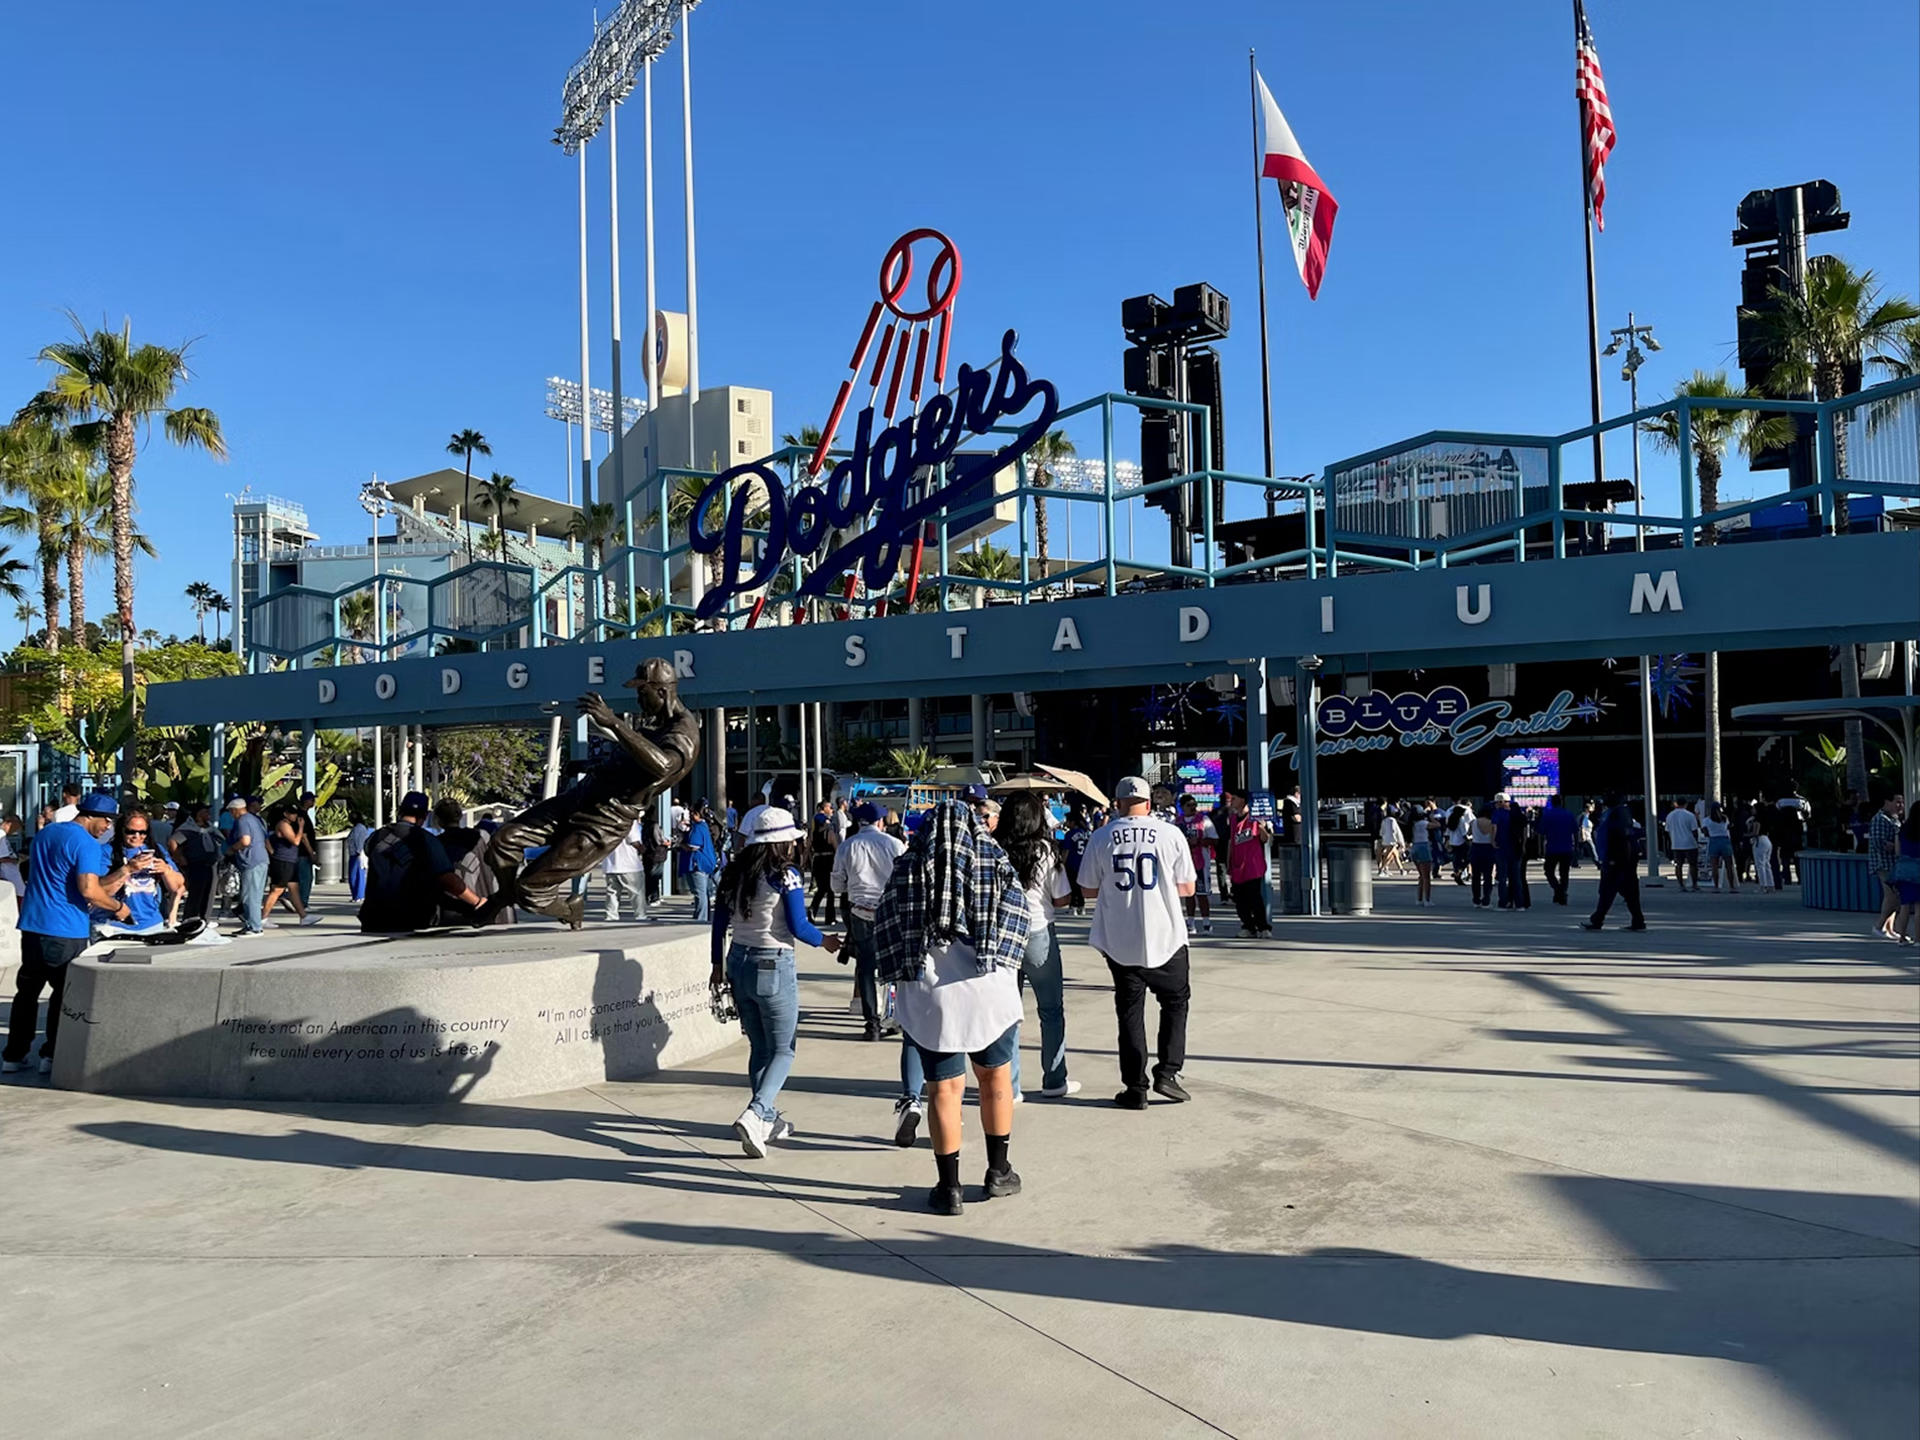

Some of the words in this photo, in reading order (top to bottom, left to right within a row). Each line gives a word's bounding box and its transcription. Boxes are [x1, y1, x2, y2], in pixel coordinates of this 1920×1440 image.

[690, 328, 1059, 619] Dodgers
[1377, 464, 1506, 504] ULTRA
[318, 649, 695, 704] DODGER
[844, 570, 1684, 667] STADIUM
[1323, 697, 1460, 726] BLUE
[1267, 732, 1393, 770] Haven
[1400, 730, 1442, 747] on
[1450, 690, 1592, 755] Earth
[1112, 827, 1157, 845] BETTS
[783, 869, 803, 891] LA
[1112, 853, 1158, 891] 50
[569, 1008, 587, 1019] not
[590, 995, 644, 1015] concerned
[664, 987, 682, 1005] your
[280, 1020, 302, 1034] not
[306, 1024, 324, 1034] an
[328, 1020, 397, 1036] American
[403, 1020, 416, 1035] in
[421, 1018, 446, 1034] this
[450, 1018, 509, 1033] country
[554, 1028, 571, 1045] All
[574, 1028, 579, 1041] I
[582, 1024, 600, 1041] ask
[603, 1024, 612, 1036] is
[614, 1018, 633, 1033] that
[634, 1018, 652, 1034] you
[654, 1010, 683, 1025] respect
[249, 1042, 276, 1058] free
[280, 1044, 310, 1059] until
[312, 1047, 353, 1063] every
[357, 1048, 384, 1059] one
[389, 1042, 405, 1060] of
[410, 1047, 426, 1058] us
[430, 1044, 443, 1057] is
[448, 1040, 493, 1056] free."
